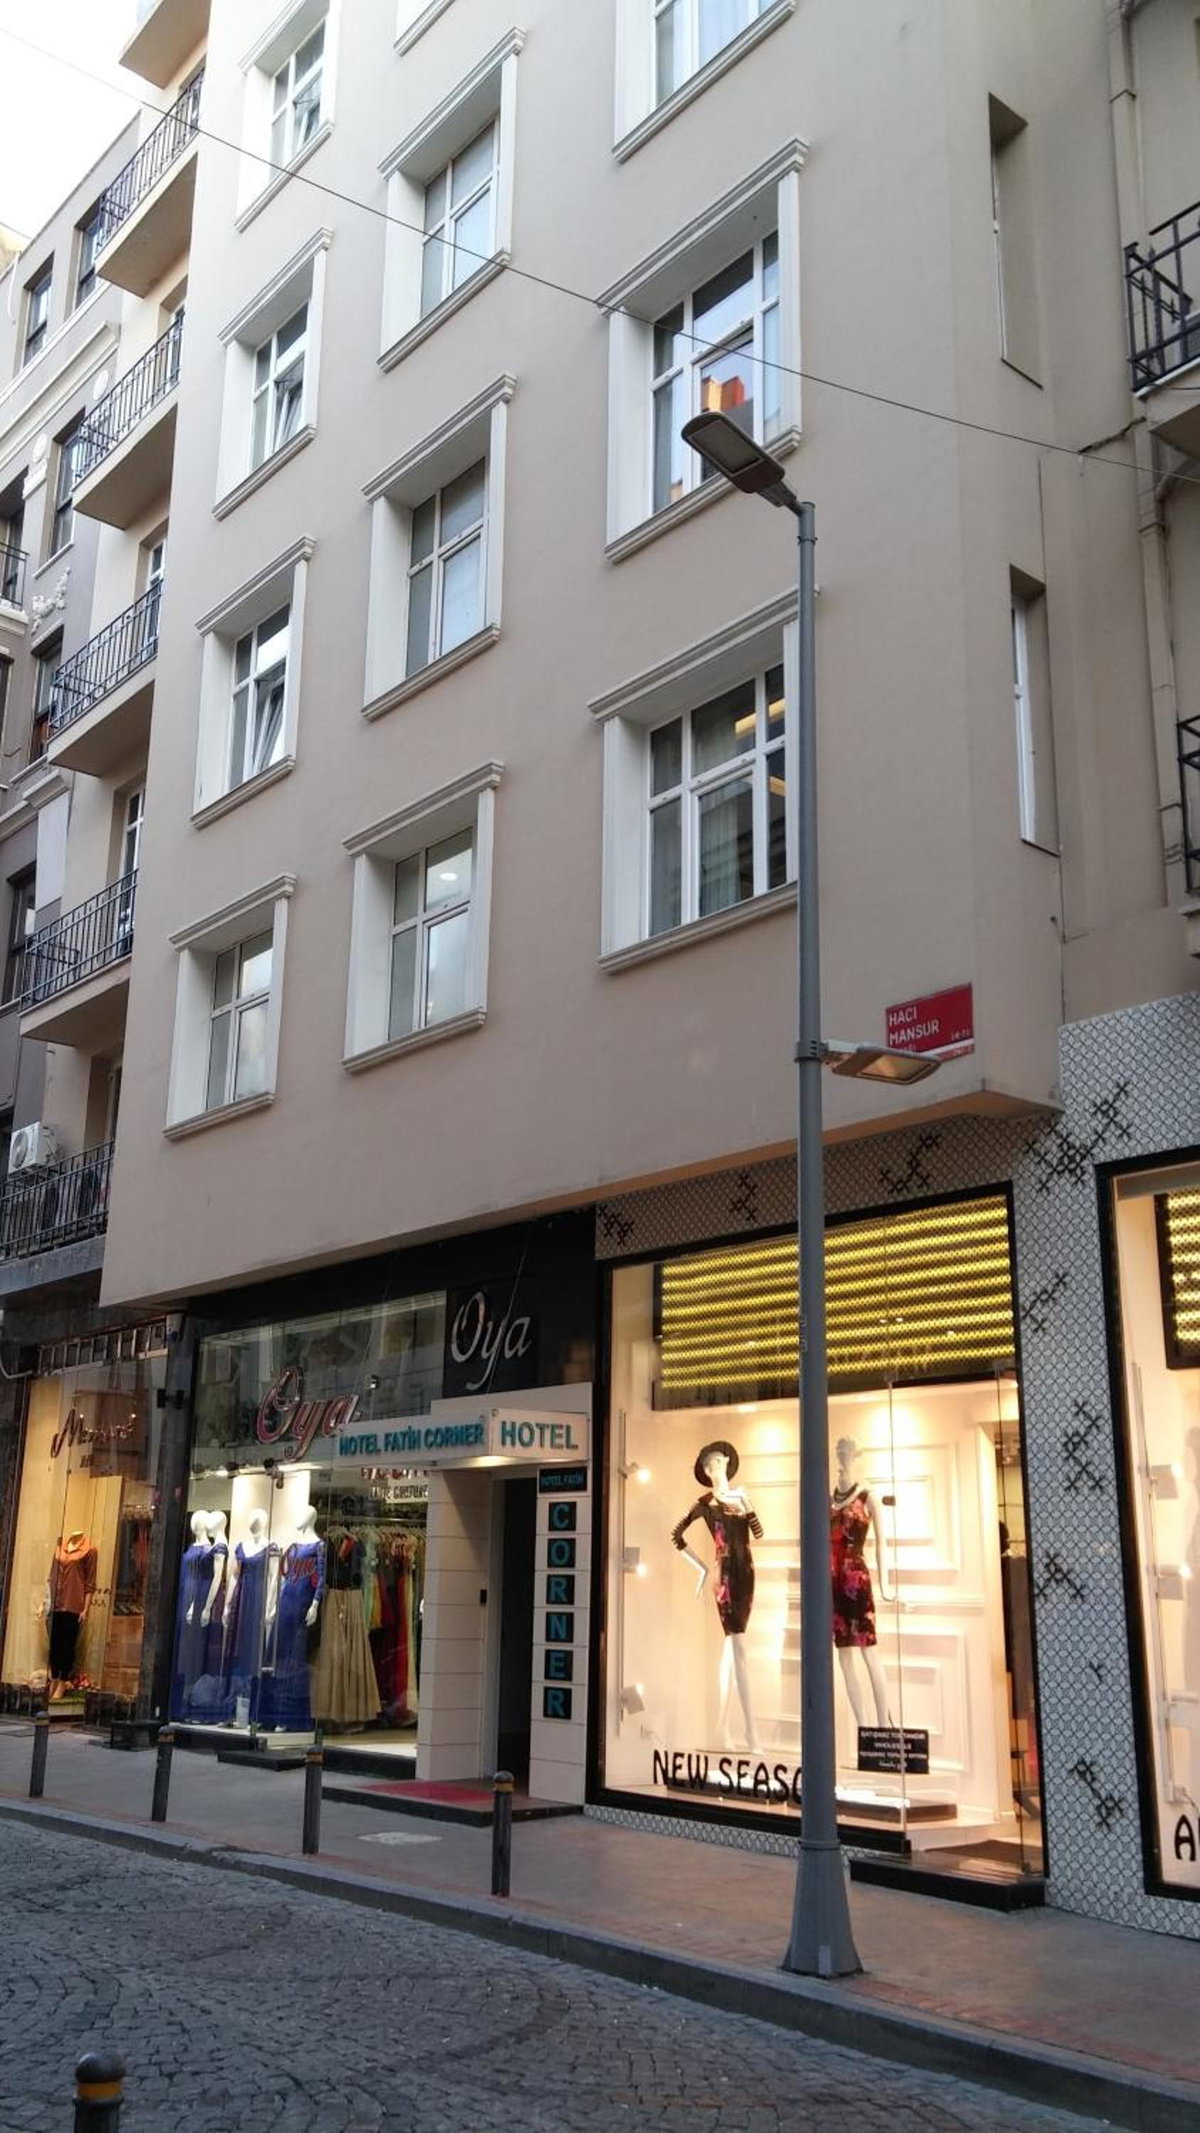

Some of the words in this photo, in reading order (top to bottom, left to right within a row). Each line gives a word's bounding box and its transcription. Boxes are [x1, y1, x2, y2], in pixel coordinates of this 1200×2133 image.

[889, 1006, 917, 1027] HACI
[889, 1019, 939, 1046] MANSUR
[451, 1291, 533, 1390] Oya
[256, 1366, 359, 1461] Oya
[339, 1433, 381, 1456] HOTEL
[423, 1423, 484, 1448] CORNER
[501, 1421, 579, 1451] HOTEL
[547, 1503, 571, 1717] CORNER
[653, 1749, 709, 1791] NEW
